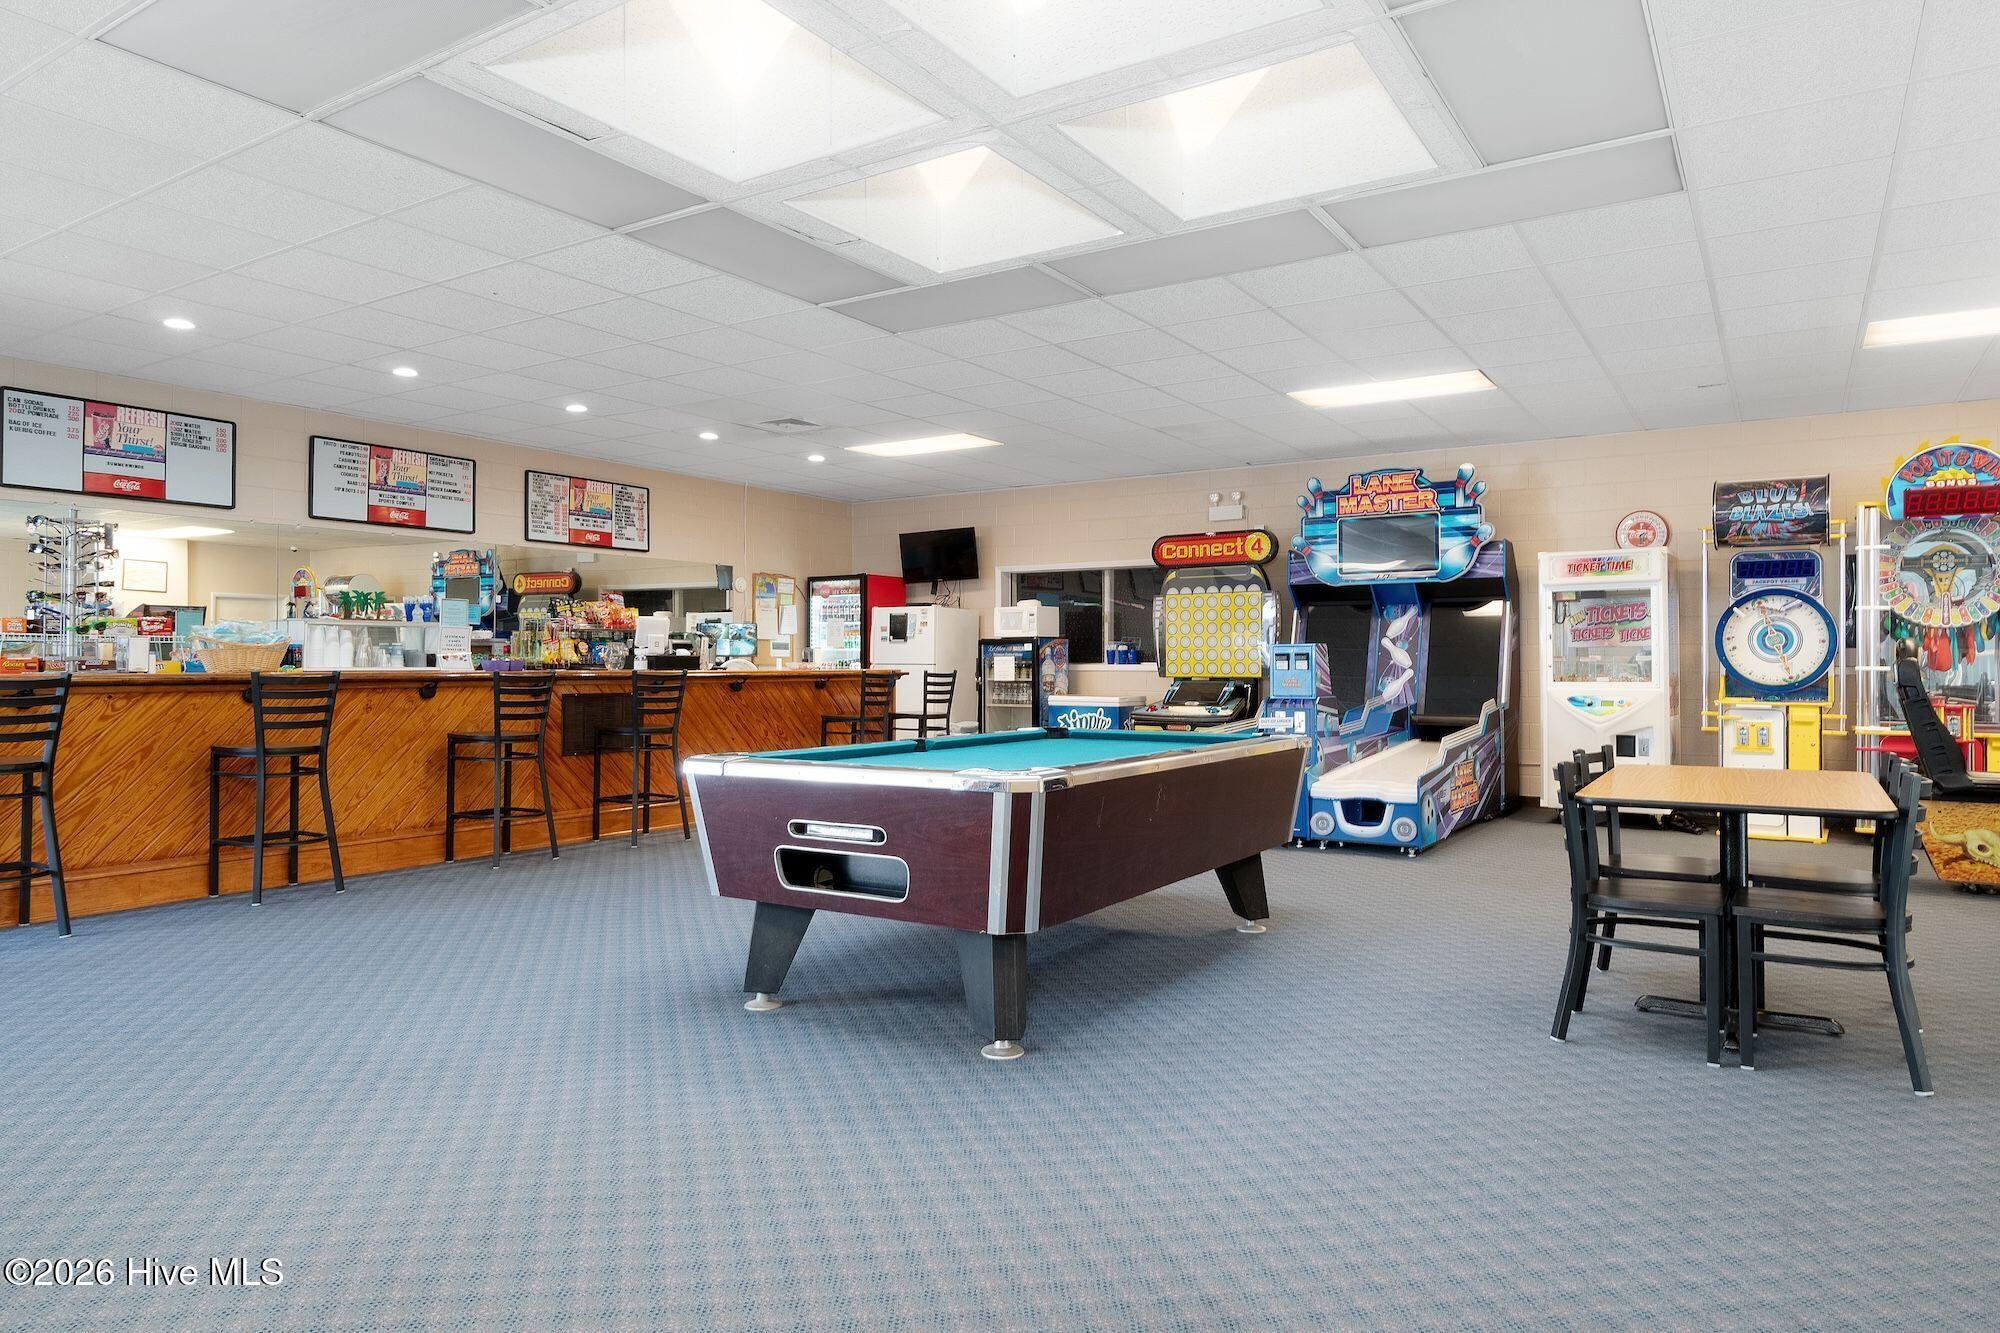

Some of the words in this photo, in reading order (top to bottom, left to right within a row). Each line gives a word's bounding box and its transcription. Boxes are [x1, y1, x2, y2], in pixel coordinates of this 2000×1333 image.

[116, 406, 166, 430] REFRESH
[34, 429, 57, 437] COFFEE
[118, 423, 143, 435] Your
[392, 448, 428, 467] REFRESH
[1900, 454, 1933, 483] POP
[1935, 450, 1954, 467] IT
[1351, 472, 1417, 495] LANE
[1925, 478, 1977, 488] BONUS
[1338, 489, 1437, 515] MASTER
[1737, 487, 1800, 504] BLUE
[1162, 536, 1244, 560] Connect
[1250, 537, 1264, 554] 4
[1567, 562, 1602, 575] TICKET
[1606, 560, 1632, 572] TIME
[1585, 601, 1648, 626] TICKETS
[1569, 627, 1616, 643] TICKETS
